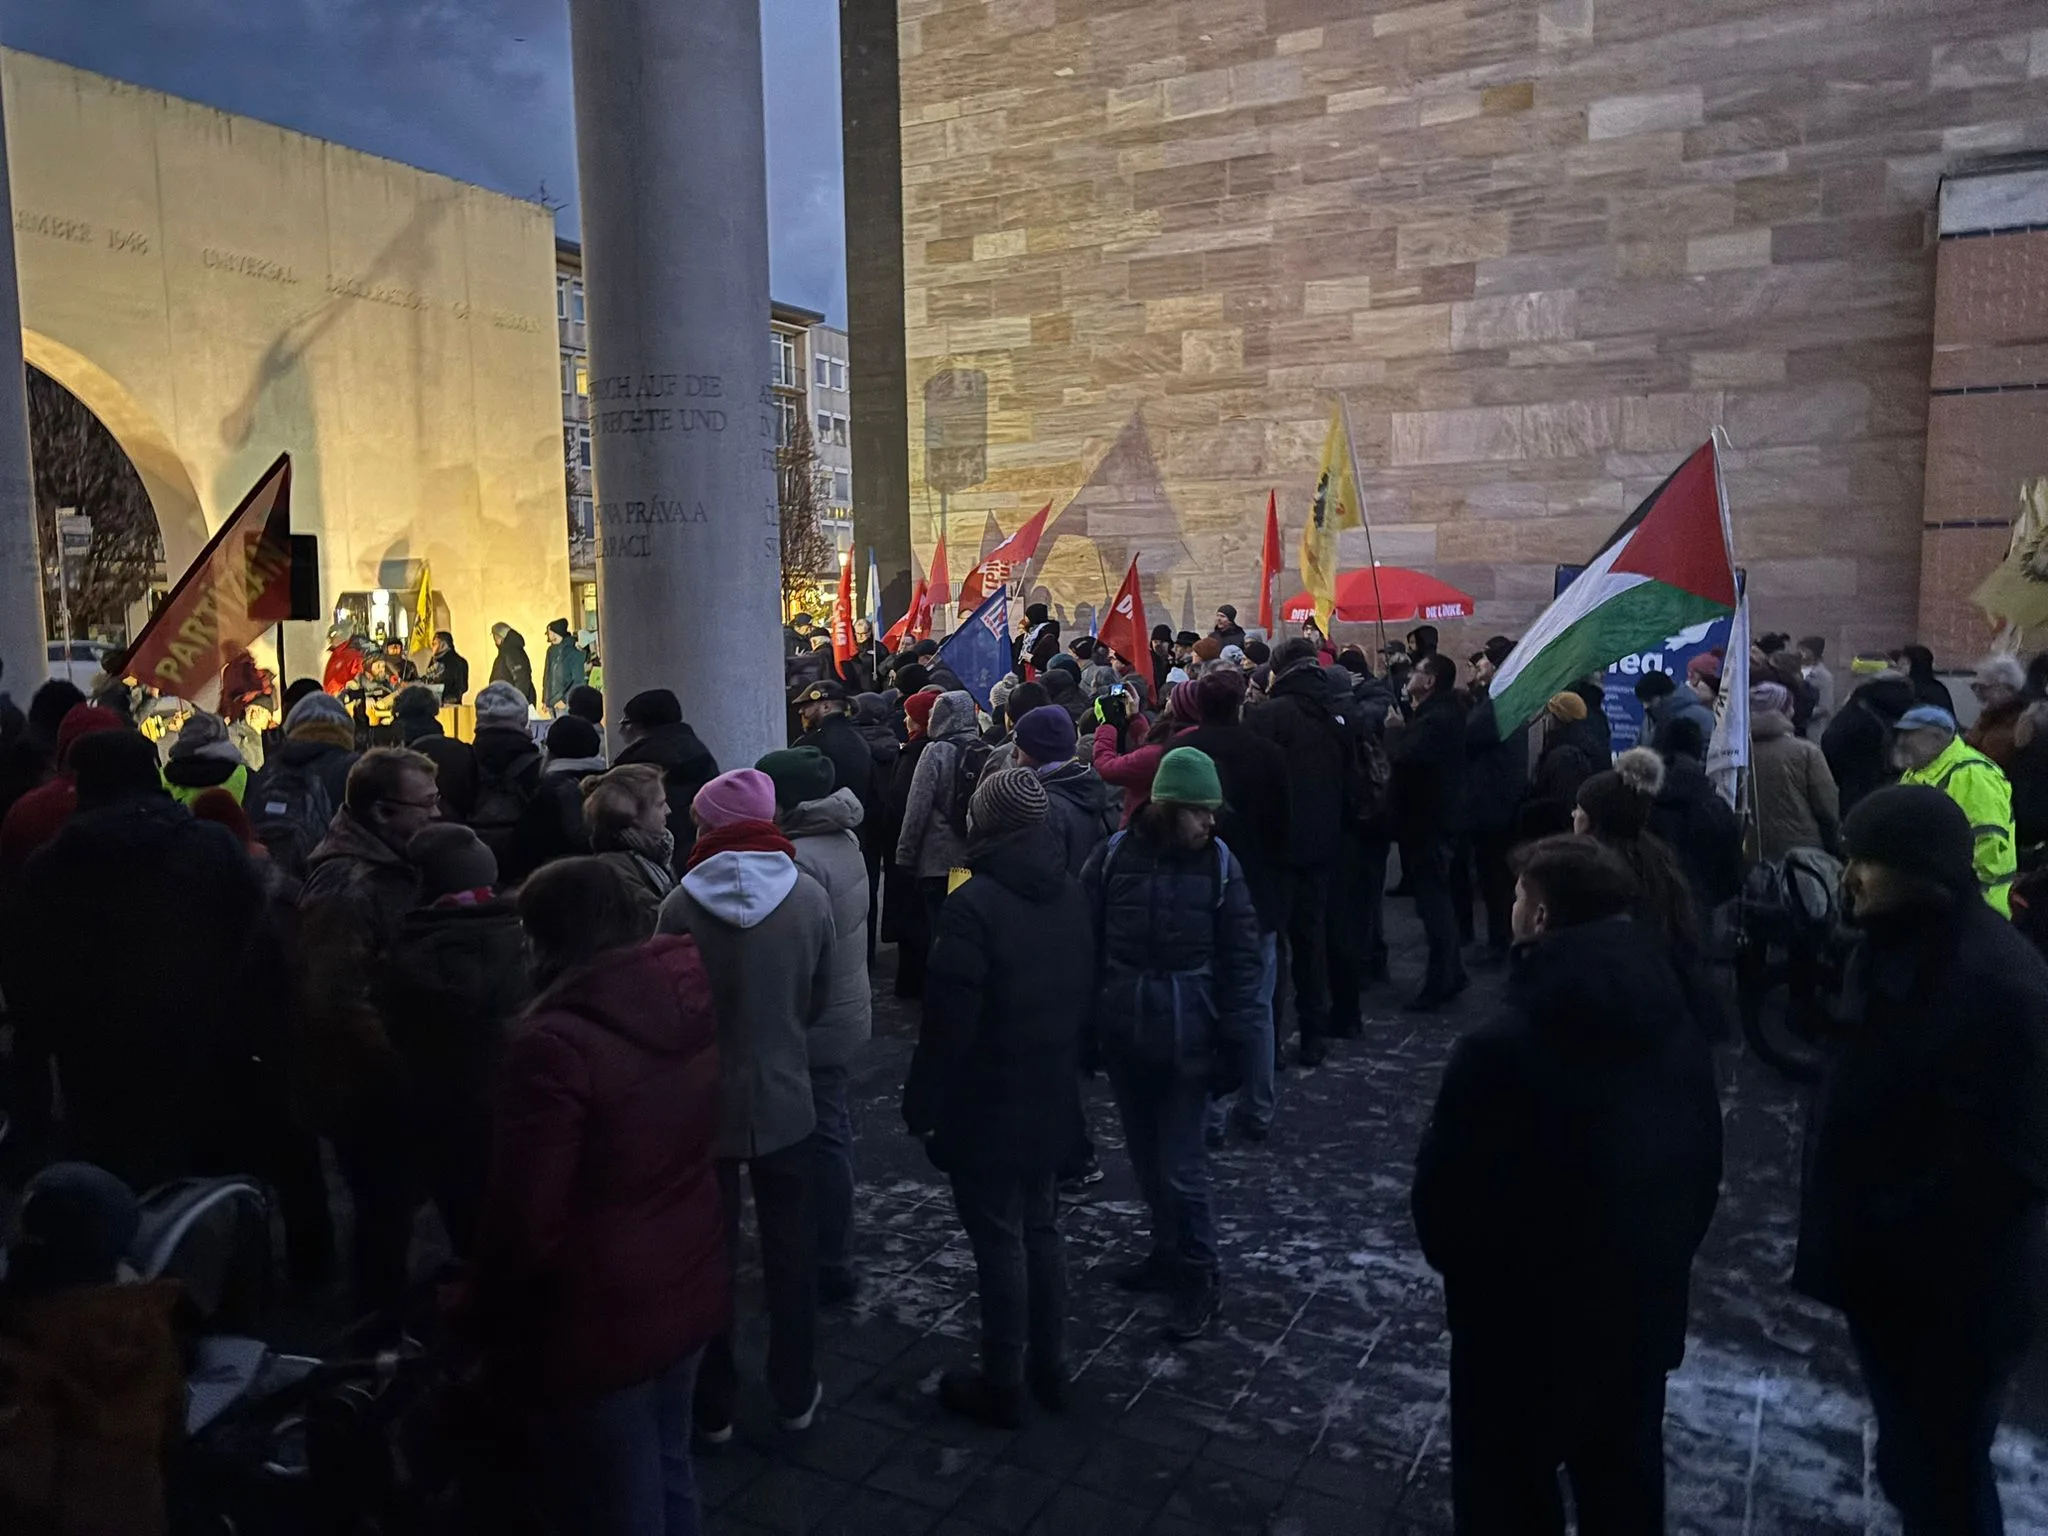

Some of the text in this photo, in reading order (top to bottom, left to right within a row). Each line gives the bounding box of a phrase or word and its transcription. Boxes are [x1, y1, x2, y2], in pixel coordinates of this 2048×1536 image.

[685, 375, 723, 398] DIE
[679, 409, 728, 432] UND
[625, 494, 688, 525] PRÁVA
